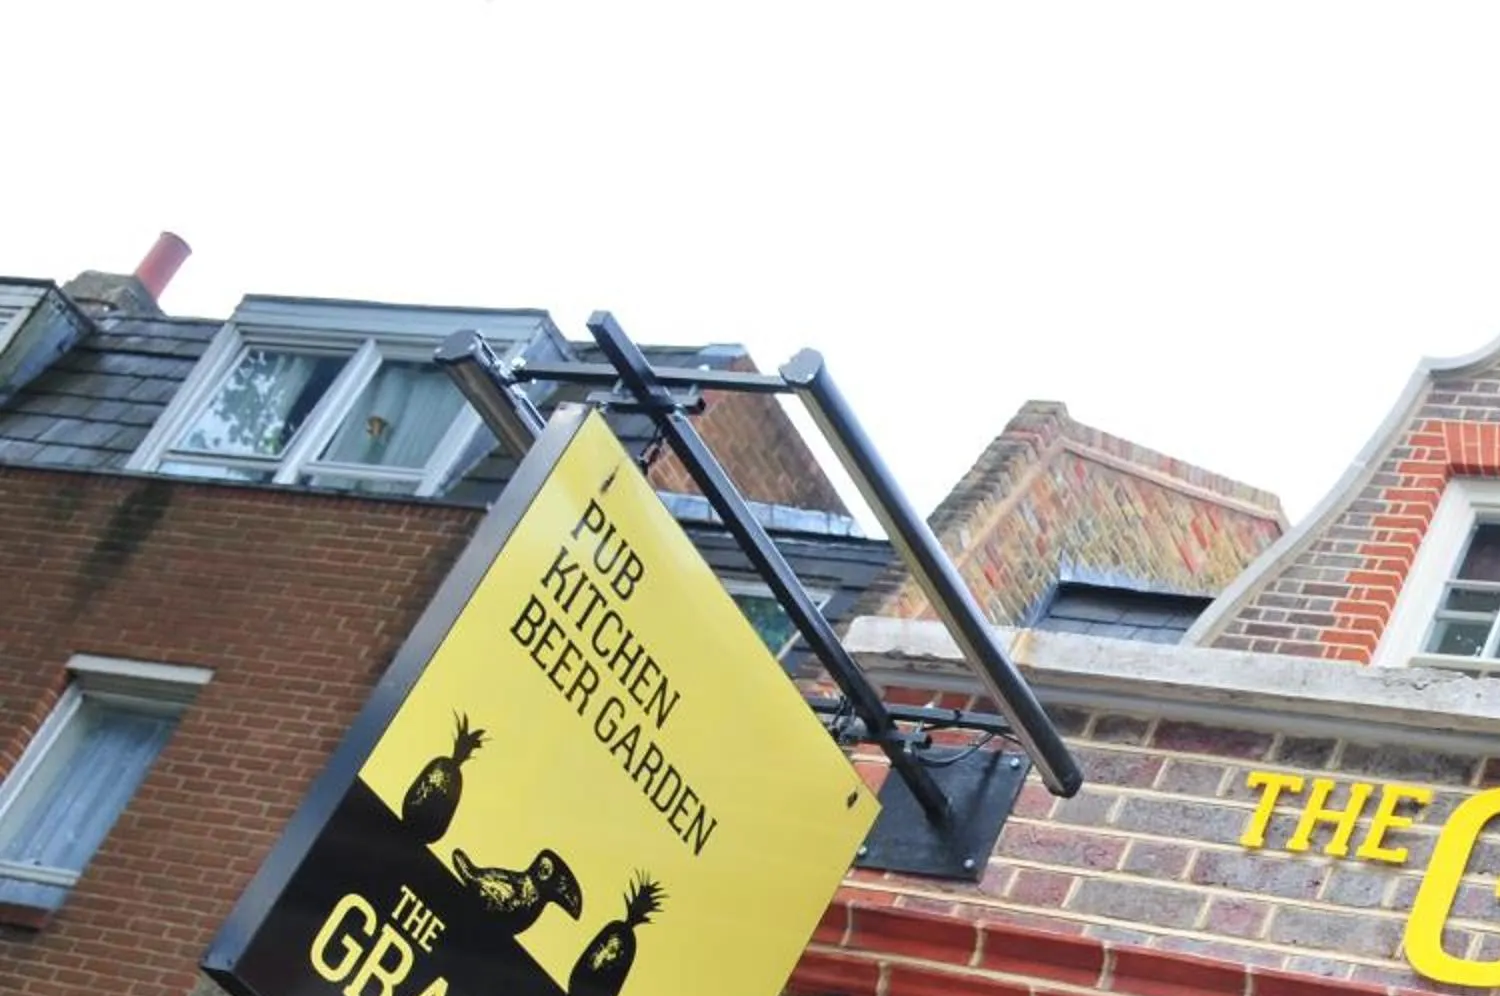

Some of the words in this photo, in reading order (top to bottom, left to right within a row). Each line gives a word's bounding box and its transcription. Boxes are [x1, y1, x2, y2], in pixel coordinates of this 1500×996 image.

[571, 498, 646, 602] PUB
[540, 545, 682, 731] KITCHEN
[508, 593, 601, 717] BEER
[593, 695, 719, 857] GARDEN
[1246, 770, 1433, 865] THE
[390, 883, 447, 955] THE
